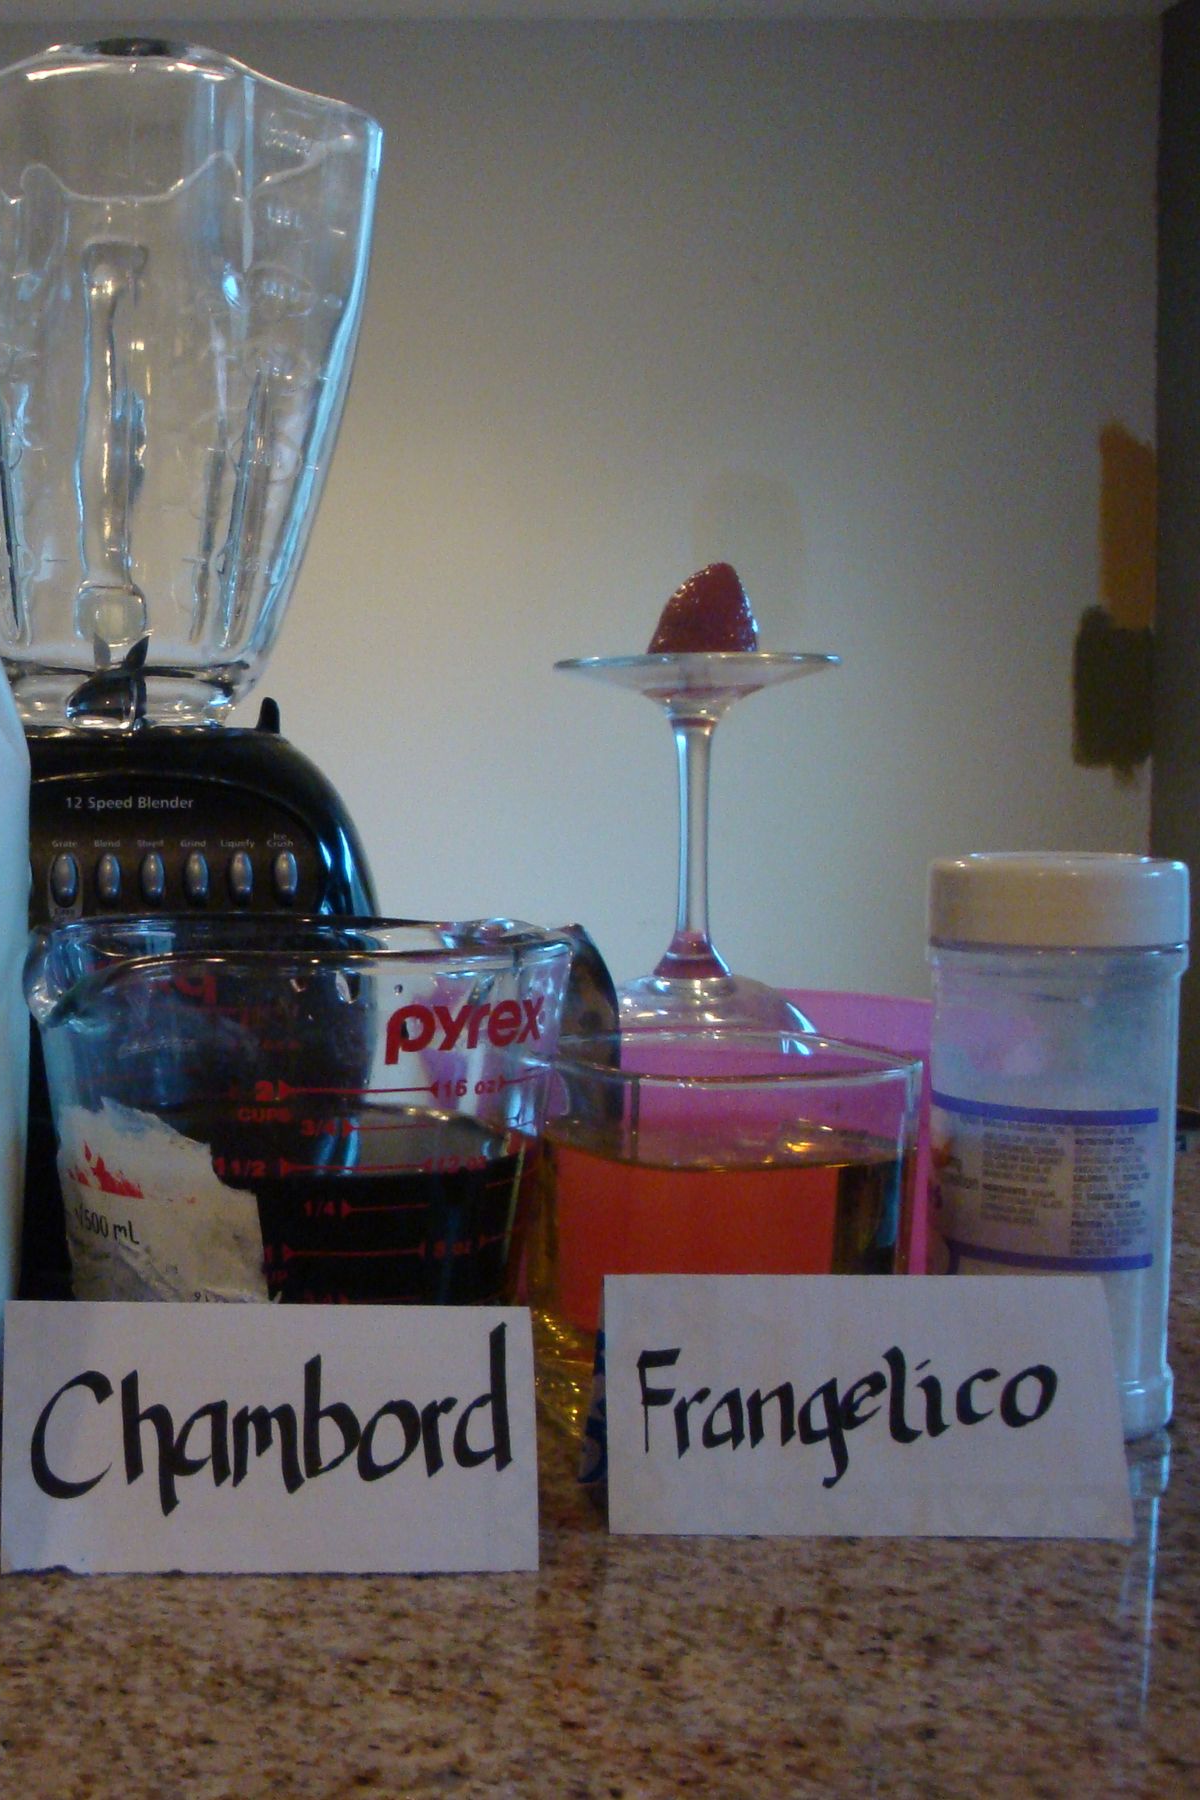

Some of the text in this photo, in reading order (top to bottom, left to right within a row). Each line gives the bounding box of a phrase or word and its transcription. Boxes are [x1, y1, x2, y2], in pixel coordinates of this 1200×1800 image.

[65, 796, 194, 813] 12 Speed Blender
[52, 839, 78, 849] Grate
[94, 838, 121, 848] Blend
[180, 838, 206, 848] Grind
[220, 839, 255, 850] Liquefy
[267, 840, 294, 849] Crush
[385, 996, 545, 1065] pyrex
[255, 1080, 274, 1102] 2
[30, 1321, 514, 1517] Chambord
[636, 1345, 1058, 1489] Frangelico
